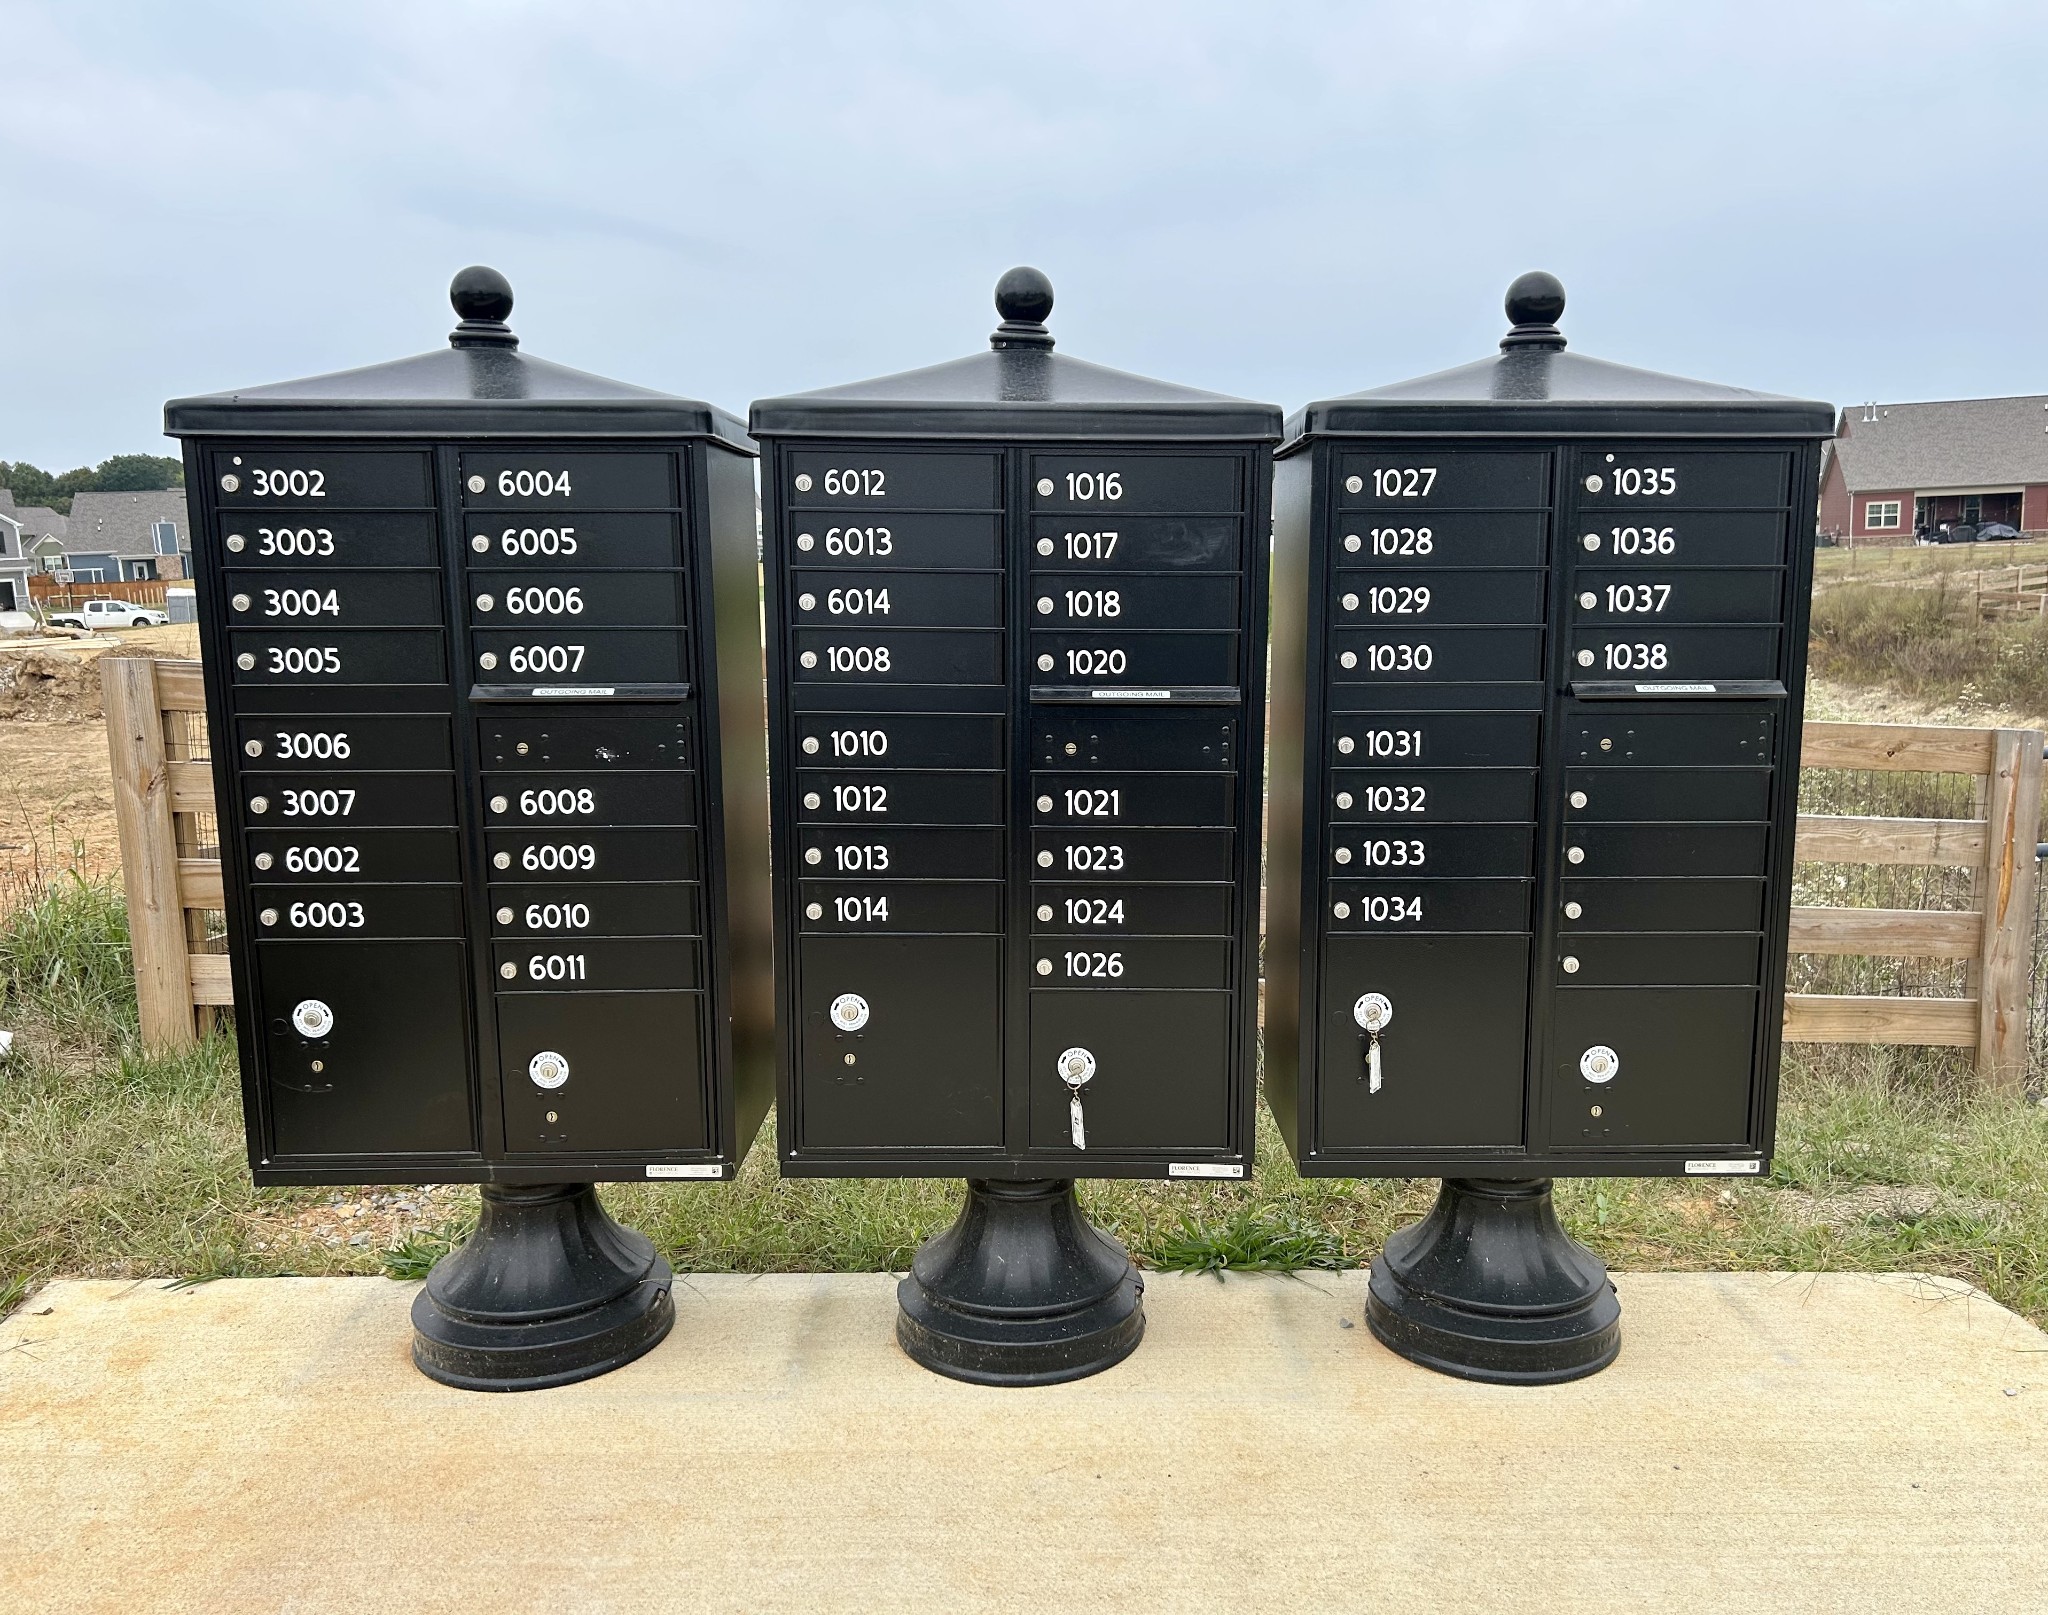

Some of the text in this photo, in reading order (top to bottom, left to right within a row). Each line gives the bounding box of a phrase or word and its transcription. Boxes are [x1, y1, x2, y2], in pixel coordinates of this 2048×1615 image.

[252, 469, 326, 497] 3002
[498, 470, 572, 497] 6004
[824, 468, 886, 496] 6012
[1065, 472, 1123, 501] 1016
[1372, 467, 1437, 497] 1027
[1612, 467, 1676, 496] 1035
[258, 528, 335, 556] 3003
[501, 527, 578, 556] 6005
[825, 527, 893, 556] 6013
[1064, 531, 1119, 560] 1017
[1370, 527, 1434, 556] 1028
[1611, 527, 1676, 555] 1036
[263, 588, 340, 617] 3004
[506, 586, 584, 615] 6006
[827, 588, 891, 615] 6014
[1064, 590, 1121, 618] 1018
[1368, 586, 1431, 614] 1029
[1605, 584, 1672, 613] 1037
[267, 647, 341, 674] 3005
[509, 645, 585, 673] 6007
[826, 646, 891, 672] 1008
[1066, 649, 1127, 675] 1020
[1367, 644, 1433, 672] 1030
[1604, 643, 1668, 670] 1038
[276, 732, 351, 760] 3006
[830, 730, 888, 757] 1010
[1366, 730, 1421, 757] 1031
[282, 789, 356, 816] 3007
[520, 788, 595, 816] 6008
[832, 785, 888, 812] 1012
[1064, 789, 1119, 816] 1021
[1365, 786, 1426, 812] 1032
[285, 846, 360, 873] 6002
[522, 844, 596, 871] 6009
[834, 845, 889, 871] 1013
[1064, 845, 1124, 871] 1023
[1362, 840, 1426, 866] 1033
[289, 902, 365, 928] 6003
[525, 903, 590, 929] 6010
[834, 896, 889, 922] 1014
[1064, 898, 1125, 924] 1024
[1361, 896, 1423, 922] 1034
[528, 954, 586, 981] 6011
[1064, 951, 1124, 978] 1026
[302, 1002, 324, 1010] OPEN
[840, 996, 861, 1004] OPEN
[1364, 995, 1385, 1004] OPEN
[538, 1054, 560, 1062] OPEN
[1067, 1050, 1088, 1059] OPEN
[1590, 1048, 1611, 1057] OPEN
